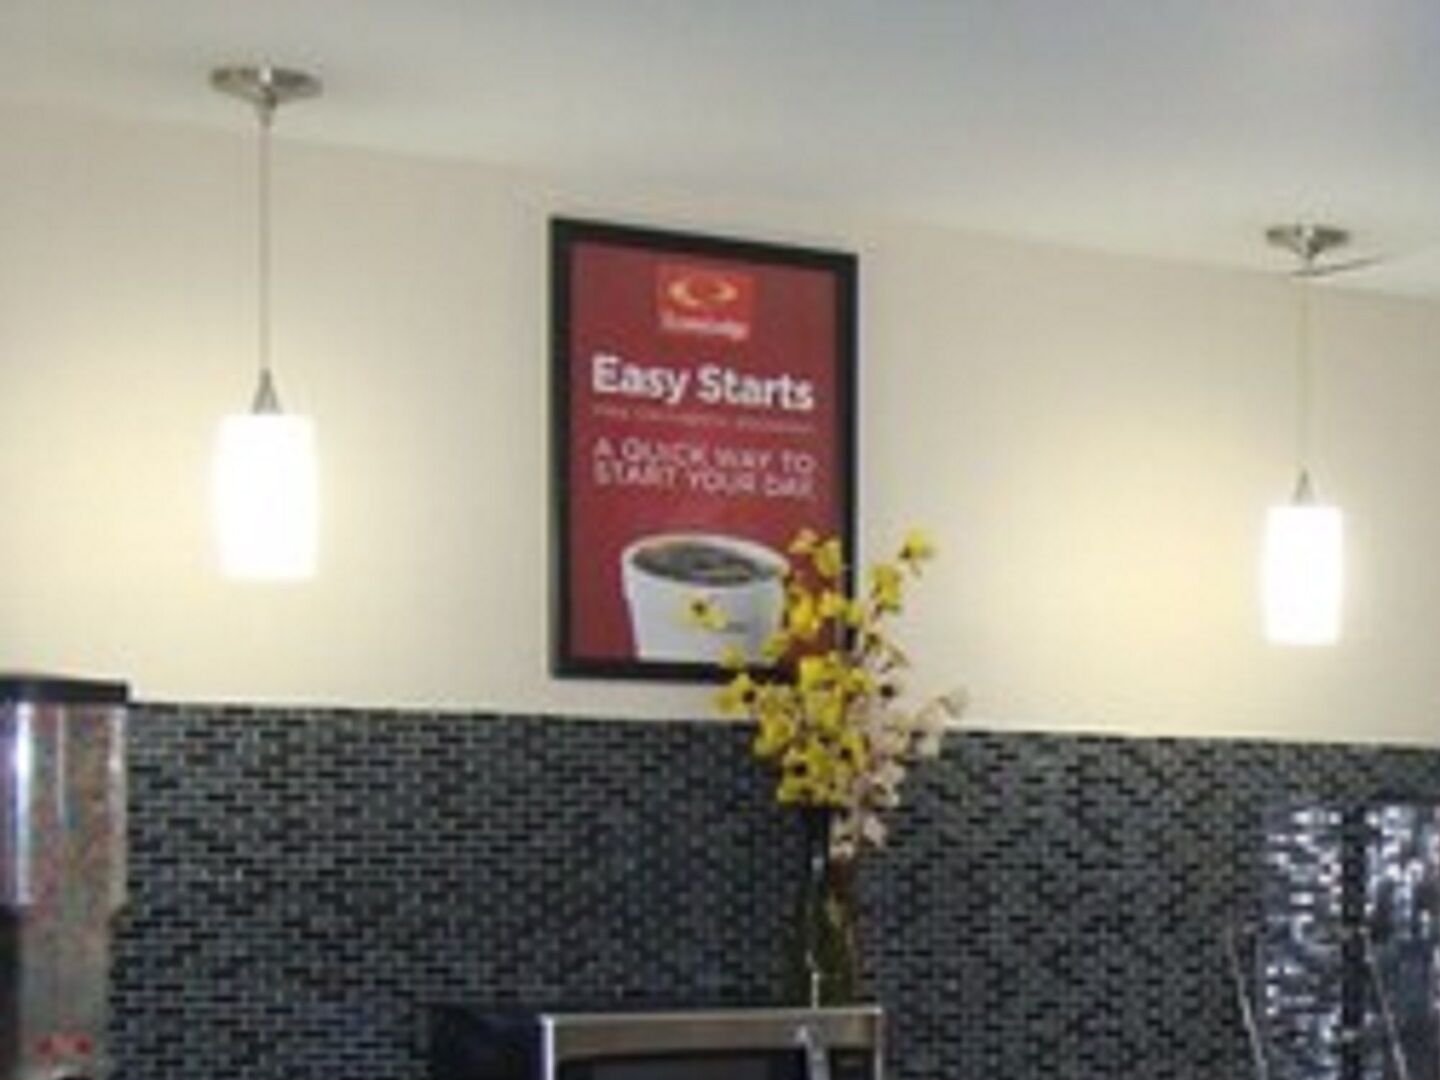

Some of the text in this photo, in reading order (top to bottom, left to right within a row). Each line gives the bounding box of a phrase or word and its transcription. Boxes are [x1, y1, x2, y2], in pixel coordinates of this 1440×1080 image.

[591, 353, 814, 411] Easy Starts
[592, 437, 817, 475] A QUICK WAY TO
[594, 460, 676, 487] START
[688, 469, 756, 494] YOUR
